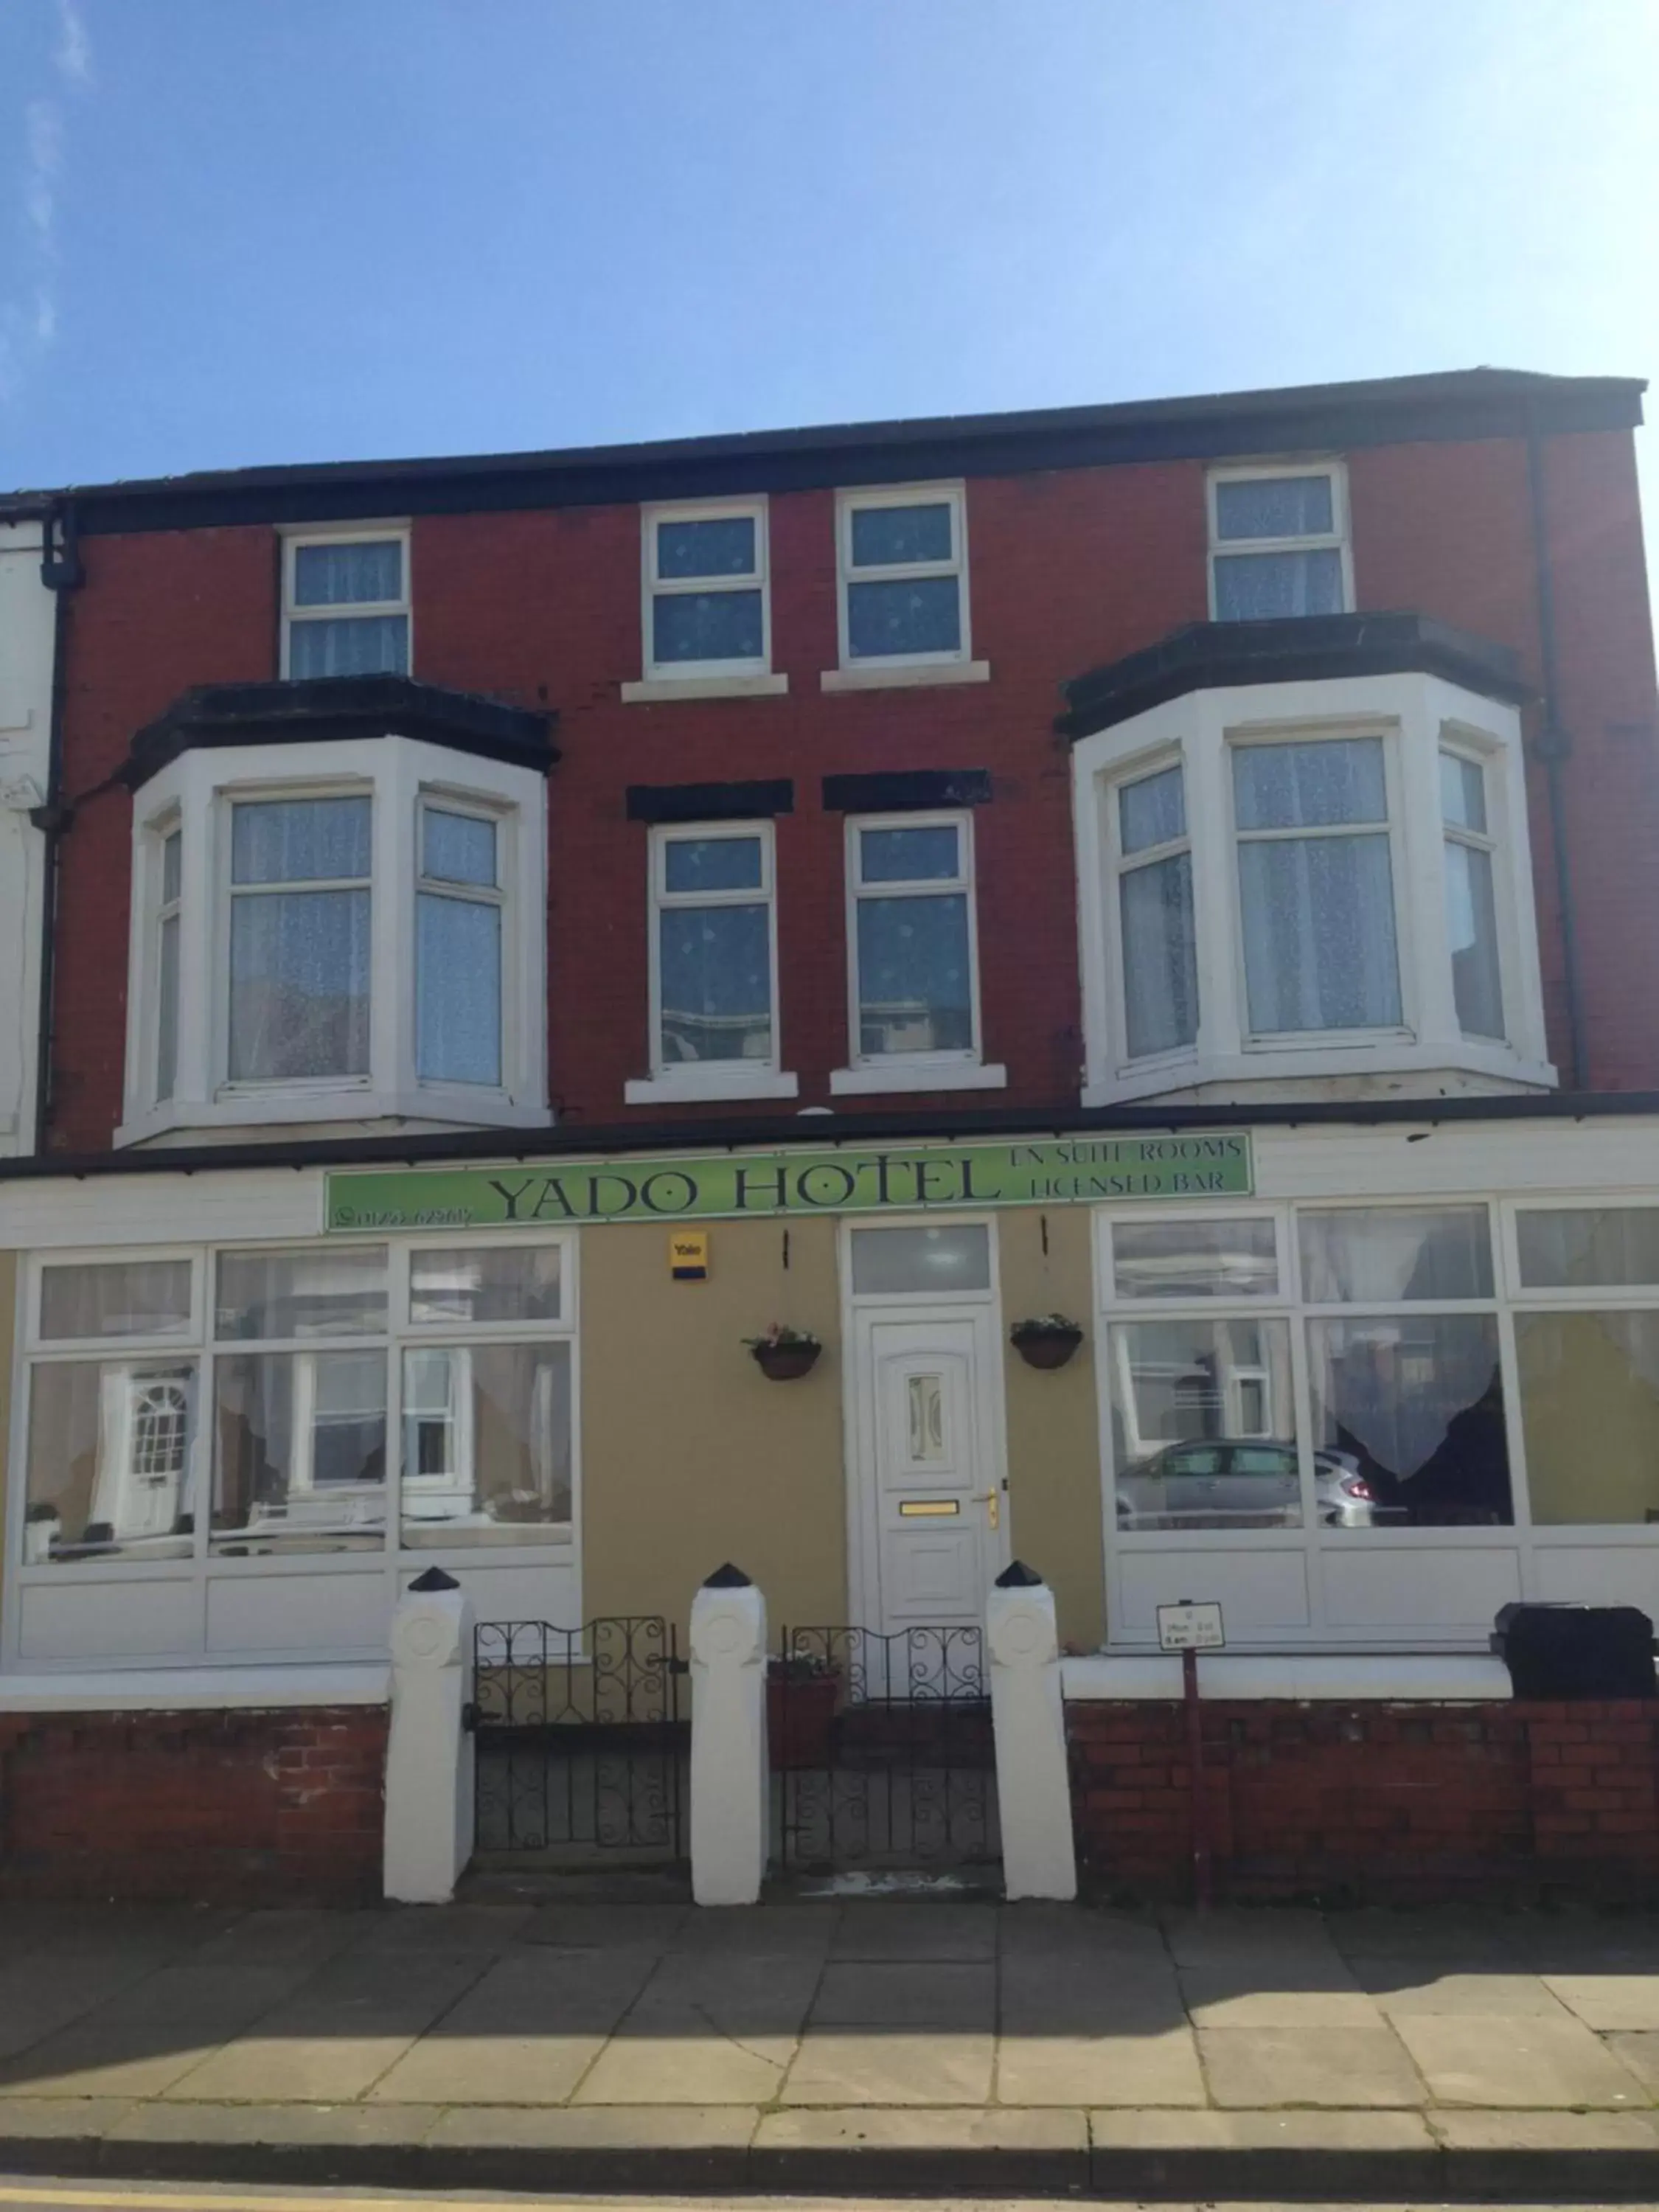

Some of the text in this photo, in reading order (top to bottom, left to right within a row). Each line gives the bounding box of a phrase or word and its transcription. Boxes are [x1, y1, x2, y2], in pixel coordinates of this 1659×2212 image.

[1010, 1138, 1242, 1167] EN SUITE ROOMS
[488, 1154, 1002, 1220] YADO HOTEL
[1031, 1171, 1225, 1198] LICENSED BAR
